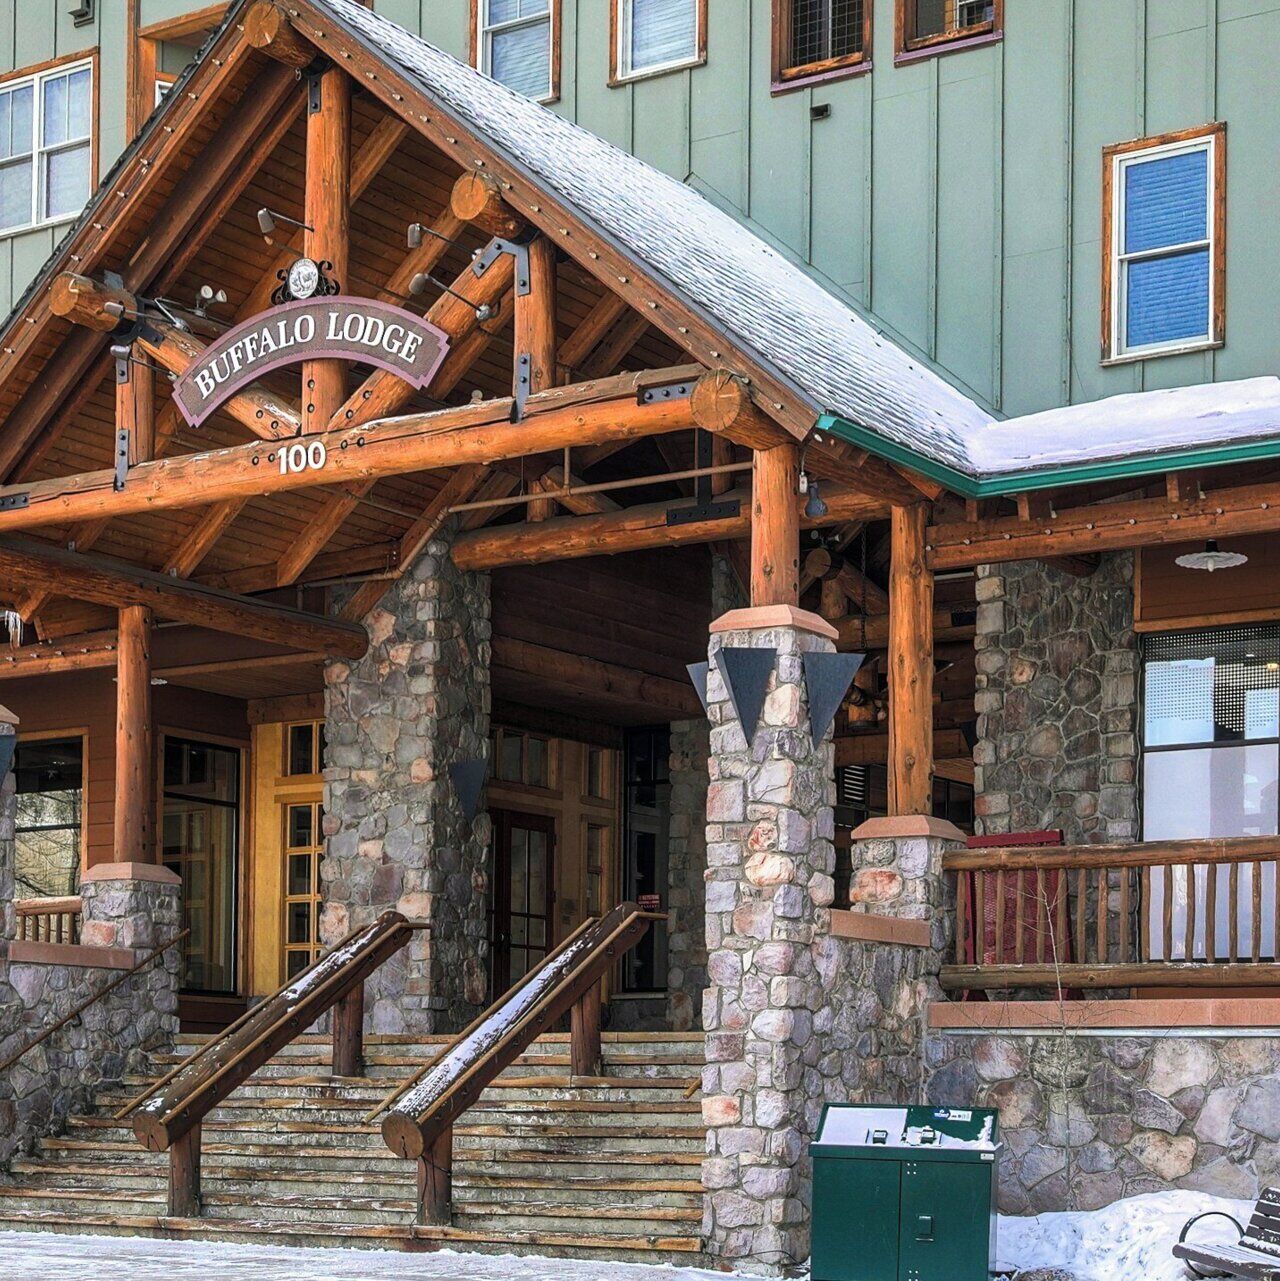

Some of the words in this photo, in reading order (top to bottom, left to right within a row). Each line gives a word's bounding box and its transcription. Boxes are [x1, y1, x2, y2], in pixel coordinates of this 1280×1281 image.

[193, 314, 315, 400] BUFFALO
[326, 312, 422, 364] LODGE
[277, 441, 326, 474] 100
